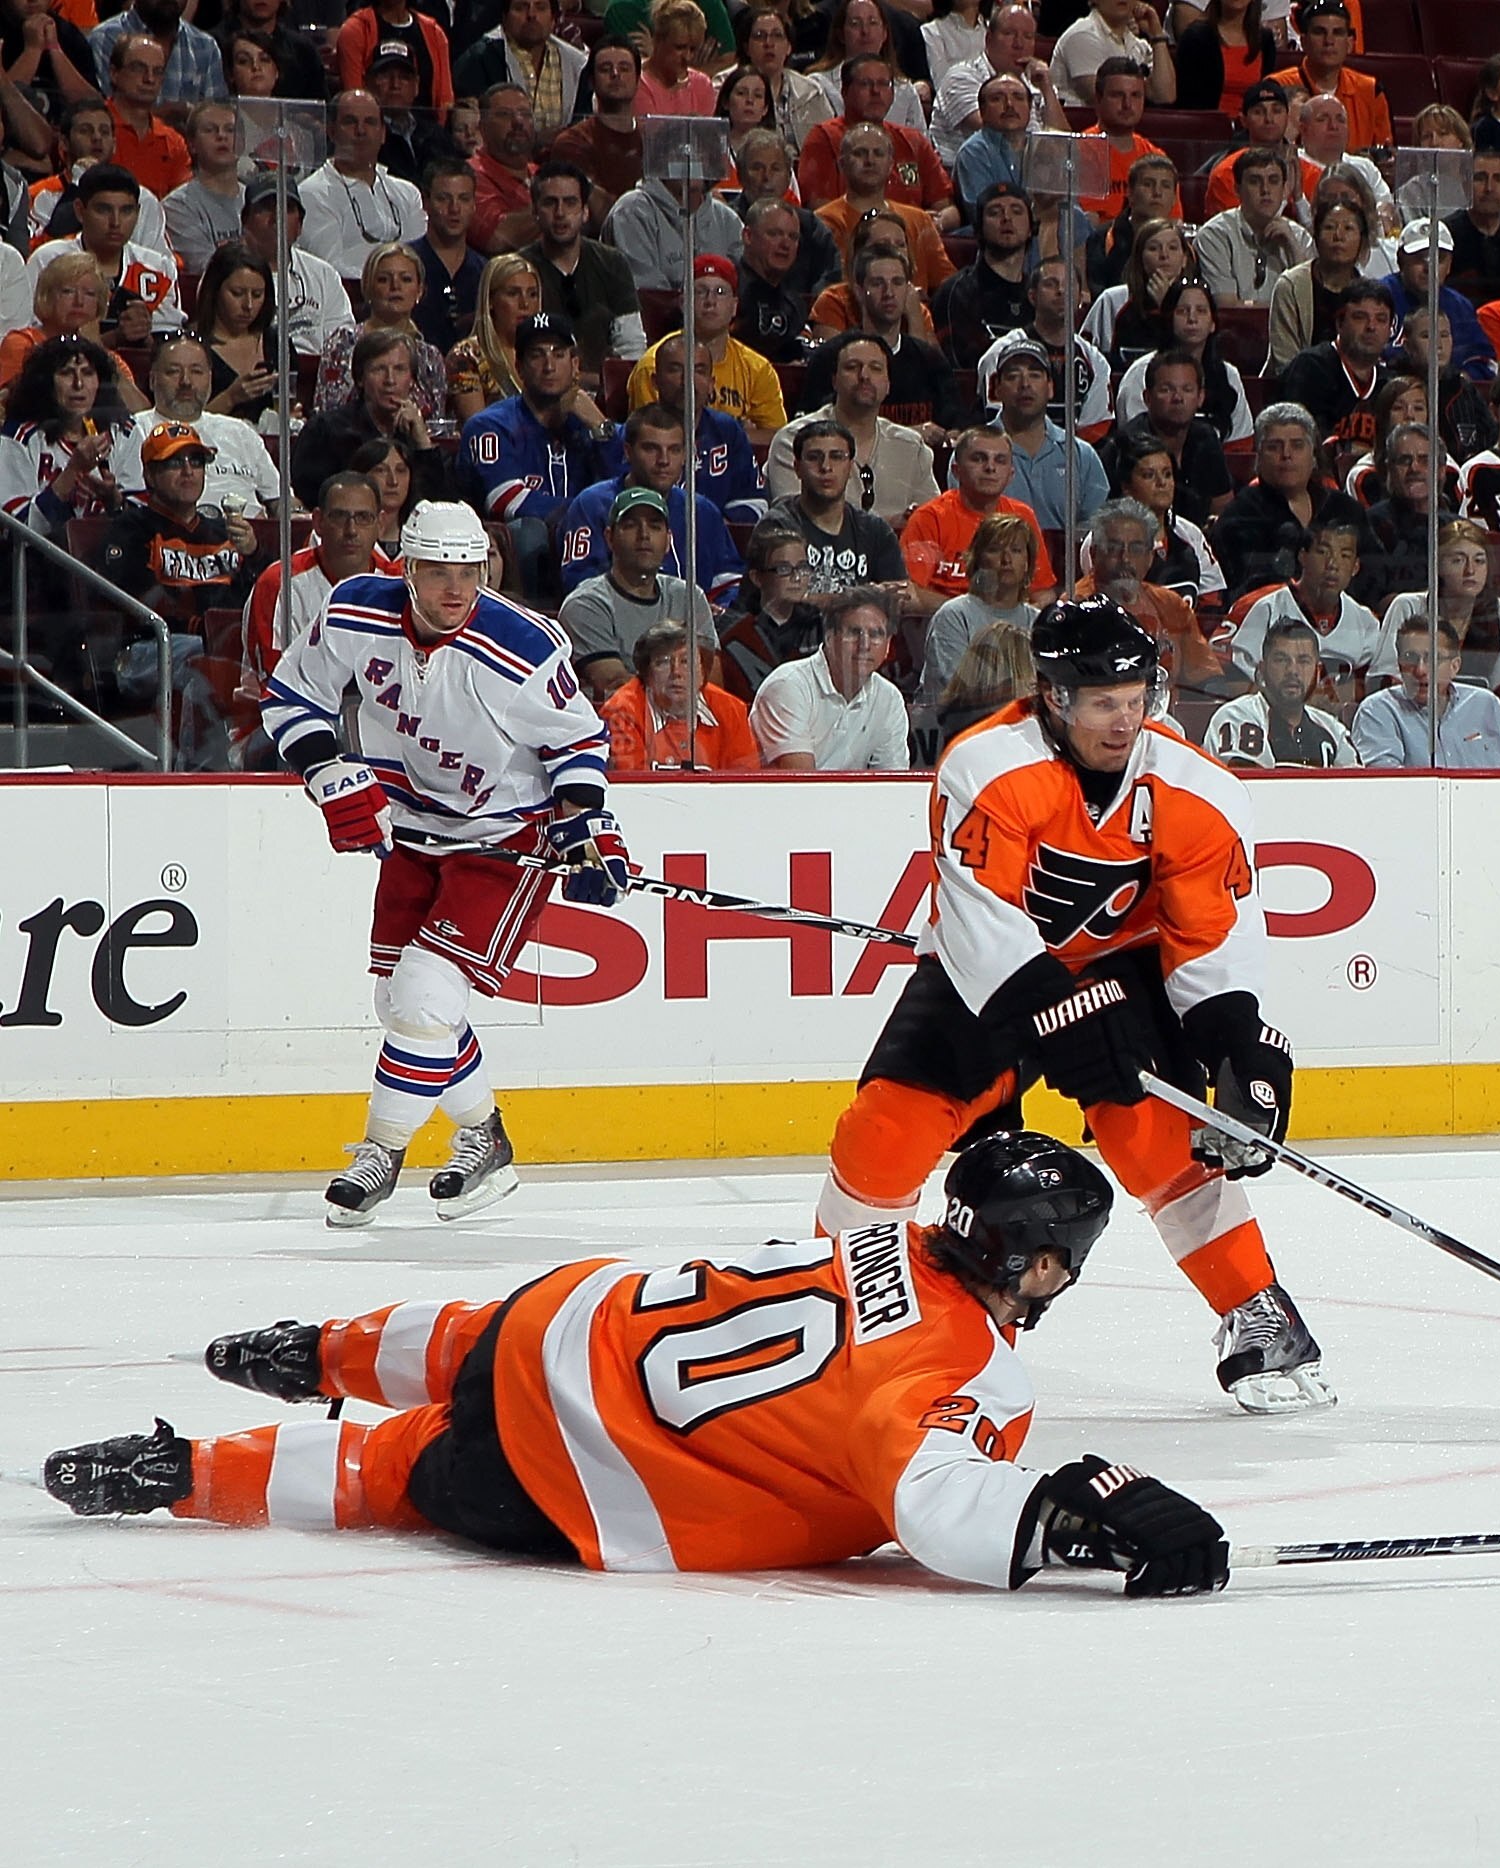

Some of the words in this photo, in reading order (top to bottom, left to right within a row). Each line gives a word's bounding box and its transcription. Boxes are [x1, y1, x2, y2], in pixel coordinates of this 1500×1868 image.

[139, 271, 158, 303] C
[468, 431, 499, 465] 10
[707, 443, 728, 477] C
[560, 526, 592, 567] 16
[546, 659, 578, 710] 10
[363, 656, 498, 816] RANGERS
[1216, 721, 1265, 758] 18
[1131, 783, 1154, 845] A
[947, 1197, 975, 1239] 20
[849, 1222, 911, 1335] RONGER
[917, 1394, 1008, 1463] 20
[59, 1461, 77, 1486] 20
